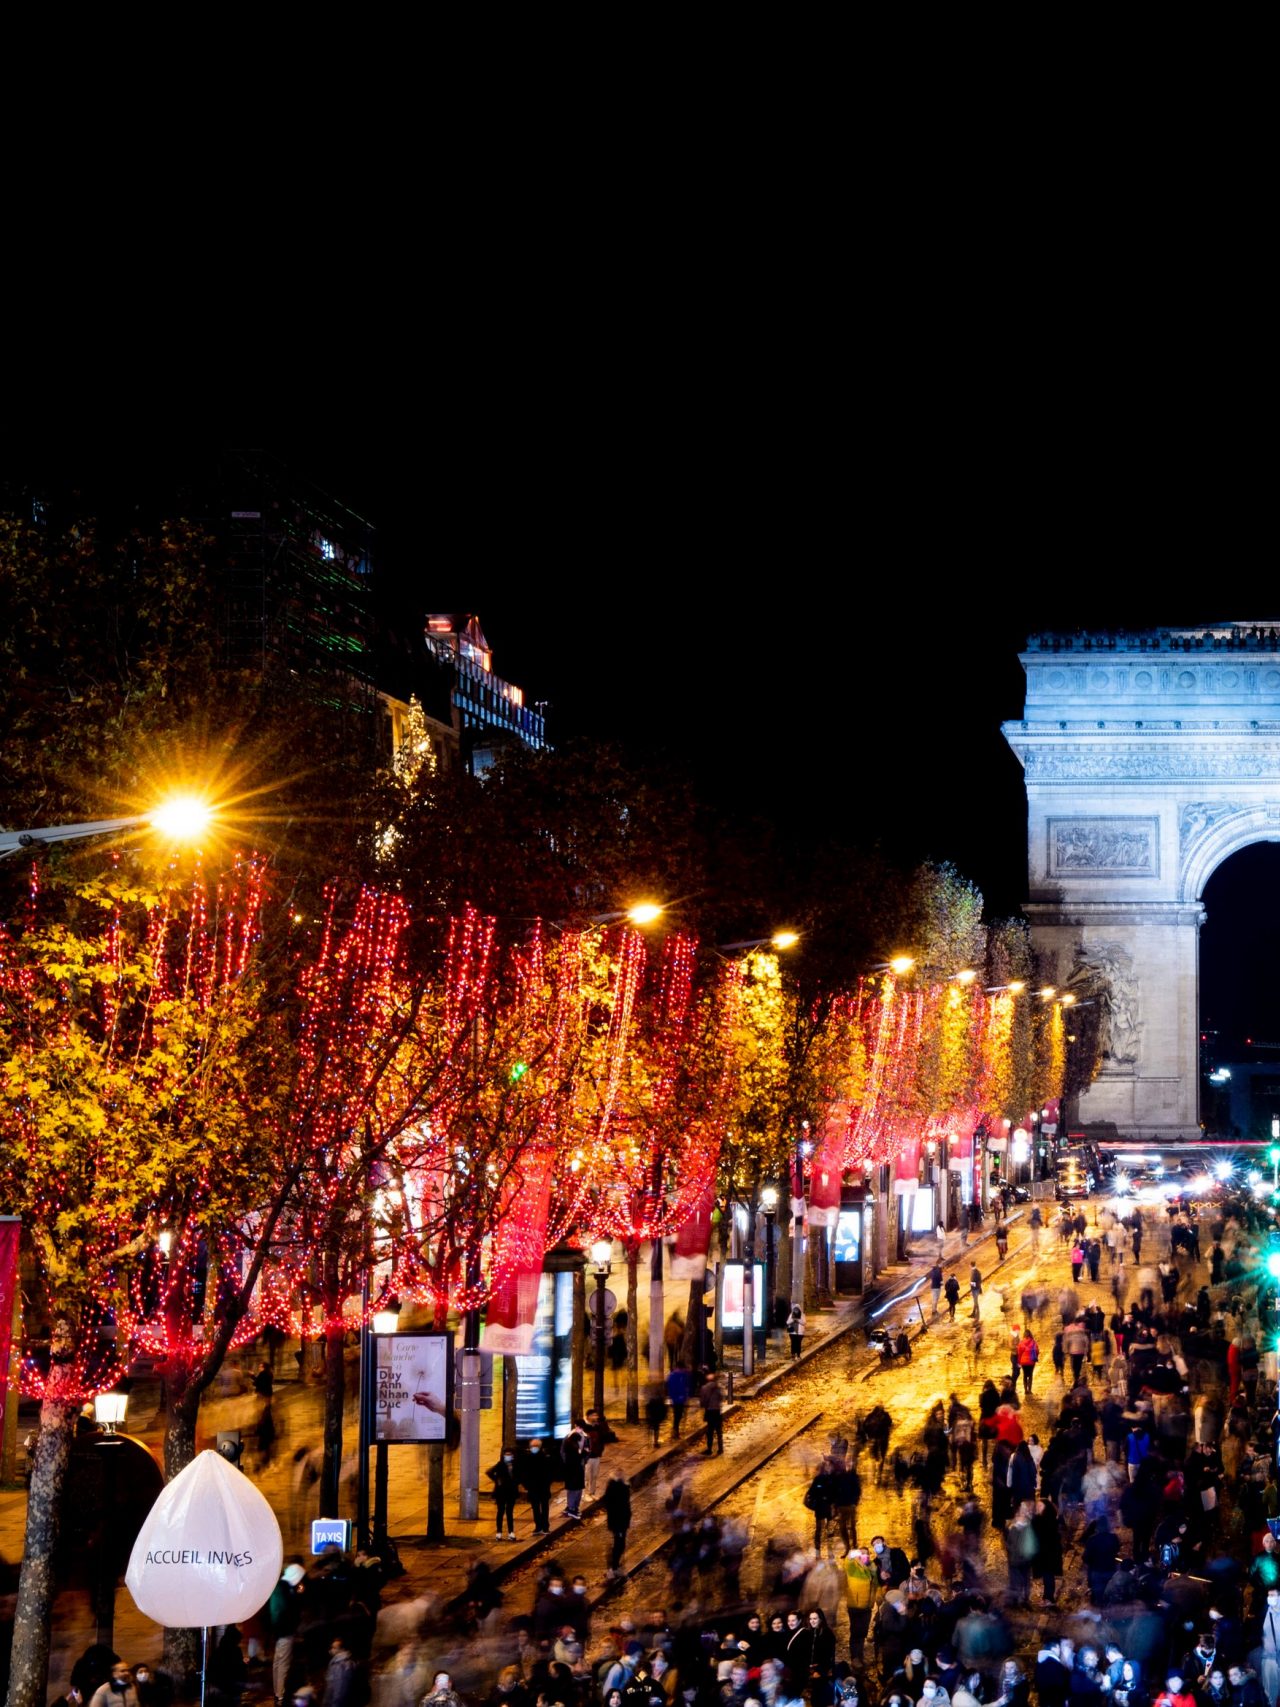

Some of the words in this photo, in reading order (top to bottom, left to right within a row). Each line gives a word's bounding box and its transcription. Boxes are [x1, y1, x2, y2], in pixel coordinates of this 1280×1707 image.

[379, 1370, 402, 1380] Duy
[379, 1380, 402, 1389] Anh
[379, 1390, 409, 1399] Nhan
[379, 1400, 401, 1409] Duc
[315, 1532, 343, 1543] TAXIS
[145, 1550, 202, 1564] ACCUEIL
